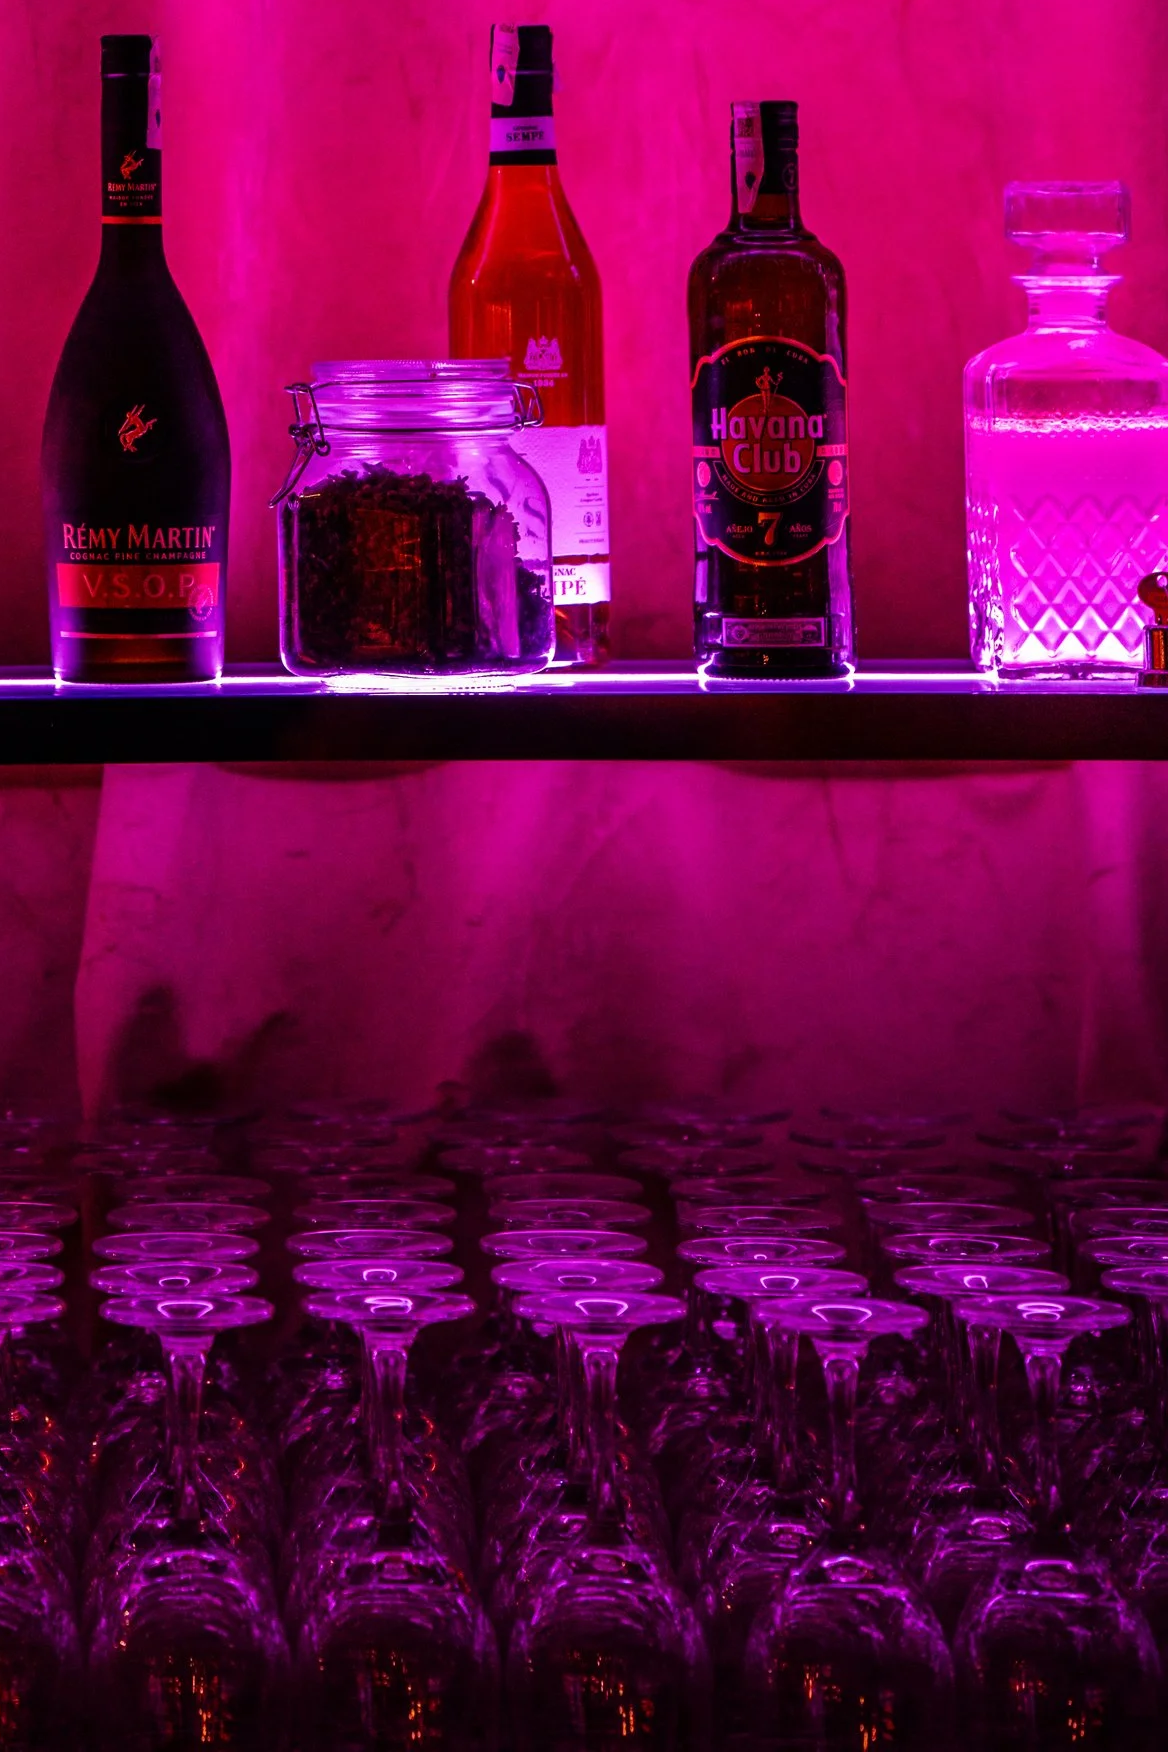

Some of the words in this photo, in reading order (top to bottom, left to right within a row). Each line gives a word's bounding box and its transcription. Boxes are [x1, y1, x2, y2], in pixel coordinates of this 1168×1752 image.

[710, 407, 824, 440] Havana
[733, 443, 802, 473] Club
[742, 491, 758, 503] AND
[62, 522, 122, 549] RÉMY
[128, 523, 213, 549] MARTIN
[726, 523, 753, 533] AÑEJO
[757, 511, 783, 546] 7
[789, 522, 812, 533] AÑOS
[70, 551, 110, 560] COGNAC
[115, 552, 140, 560] FINE
[146, 551, 206, 560] CHAMPAGNE
